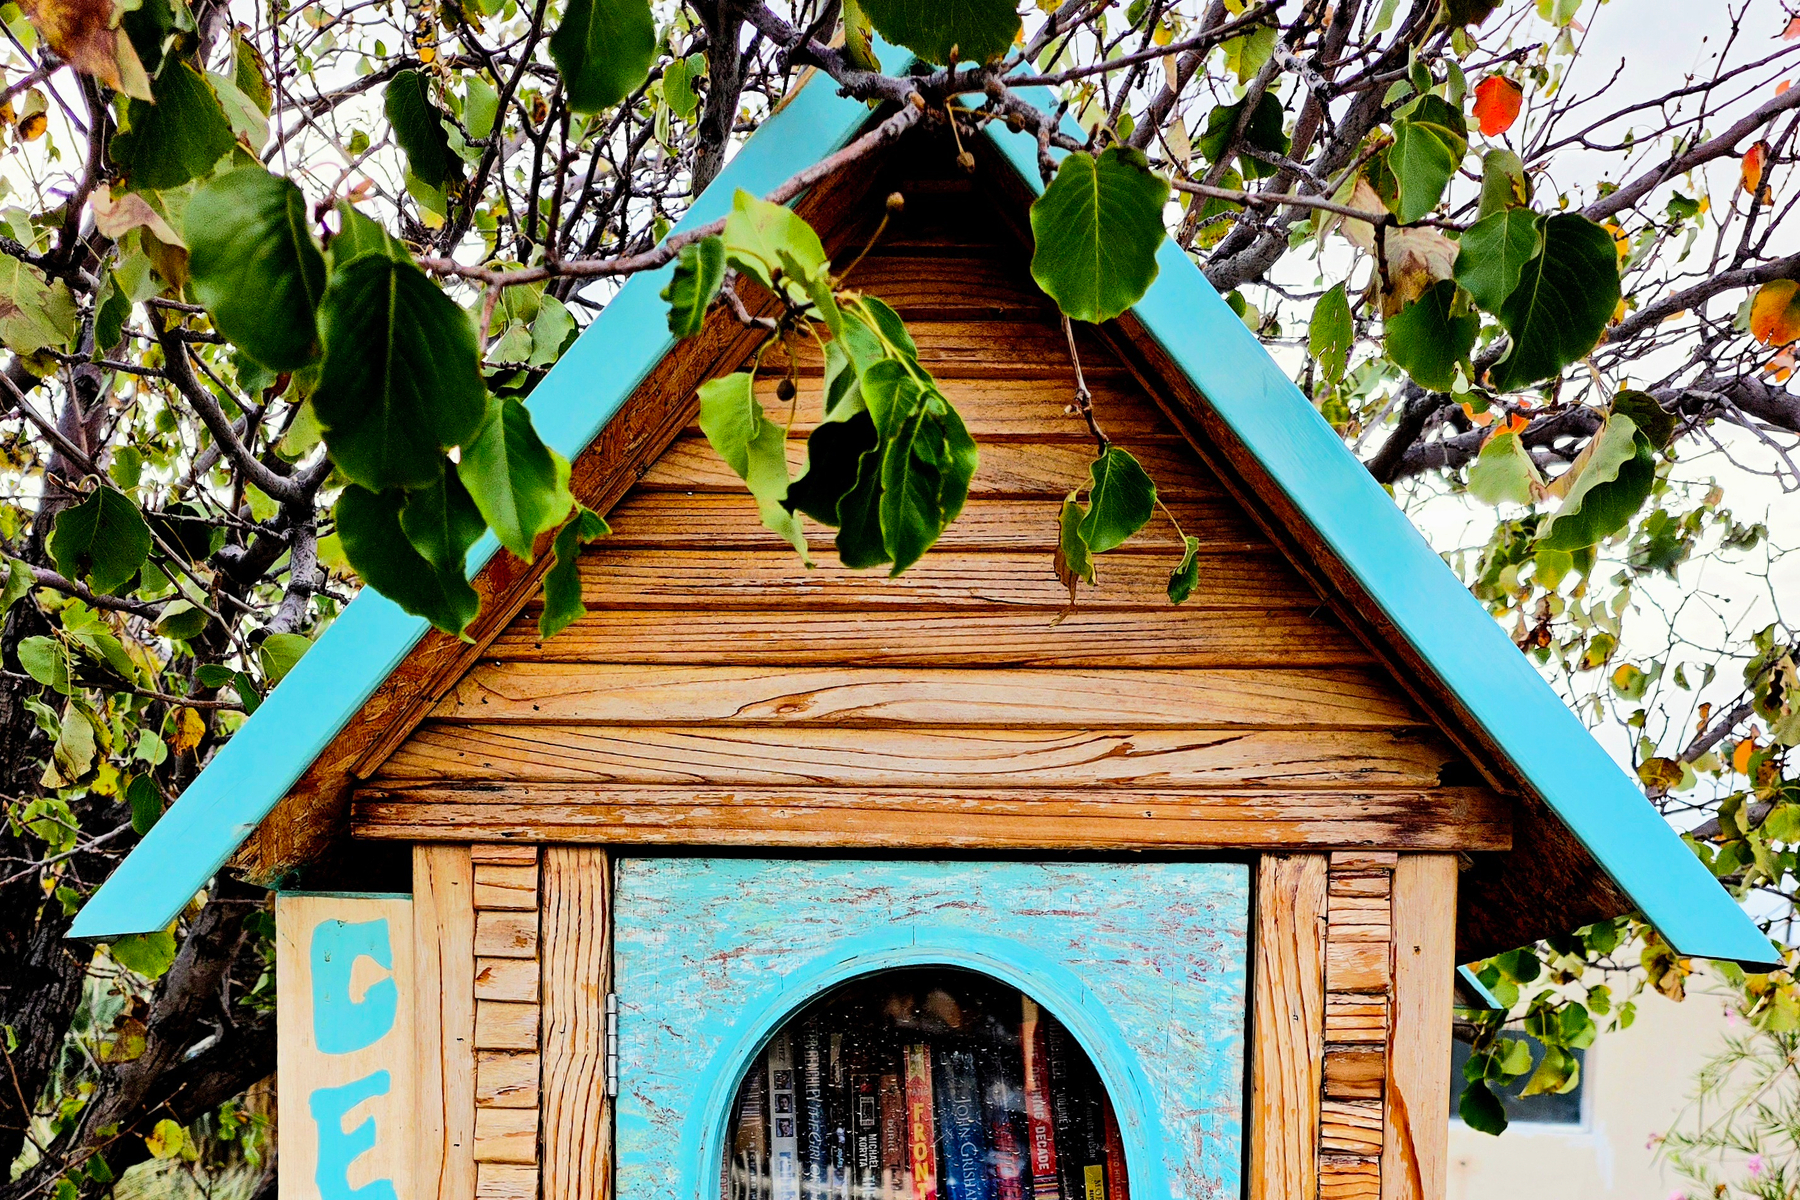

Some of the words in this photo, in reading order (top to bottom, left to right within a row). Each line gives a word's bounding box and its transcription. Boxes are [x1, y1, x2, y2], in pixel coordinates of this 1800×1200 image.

[804, 1050, 824, 1102] BENCHLEY
[953, 1097, 973, 1138] JOHN
[858, 1136, 870, 1168] KORYTA
[868, 1133, 879, 1170] MICHAEL
[911, 1102, 930, 1200] FRONT
[1034, 1125, 1050, 1171] DECADE
[862, 1174, 876, 1198] THE
